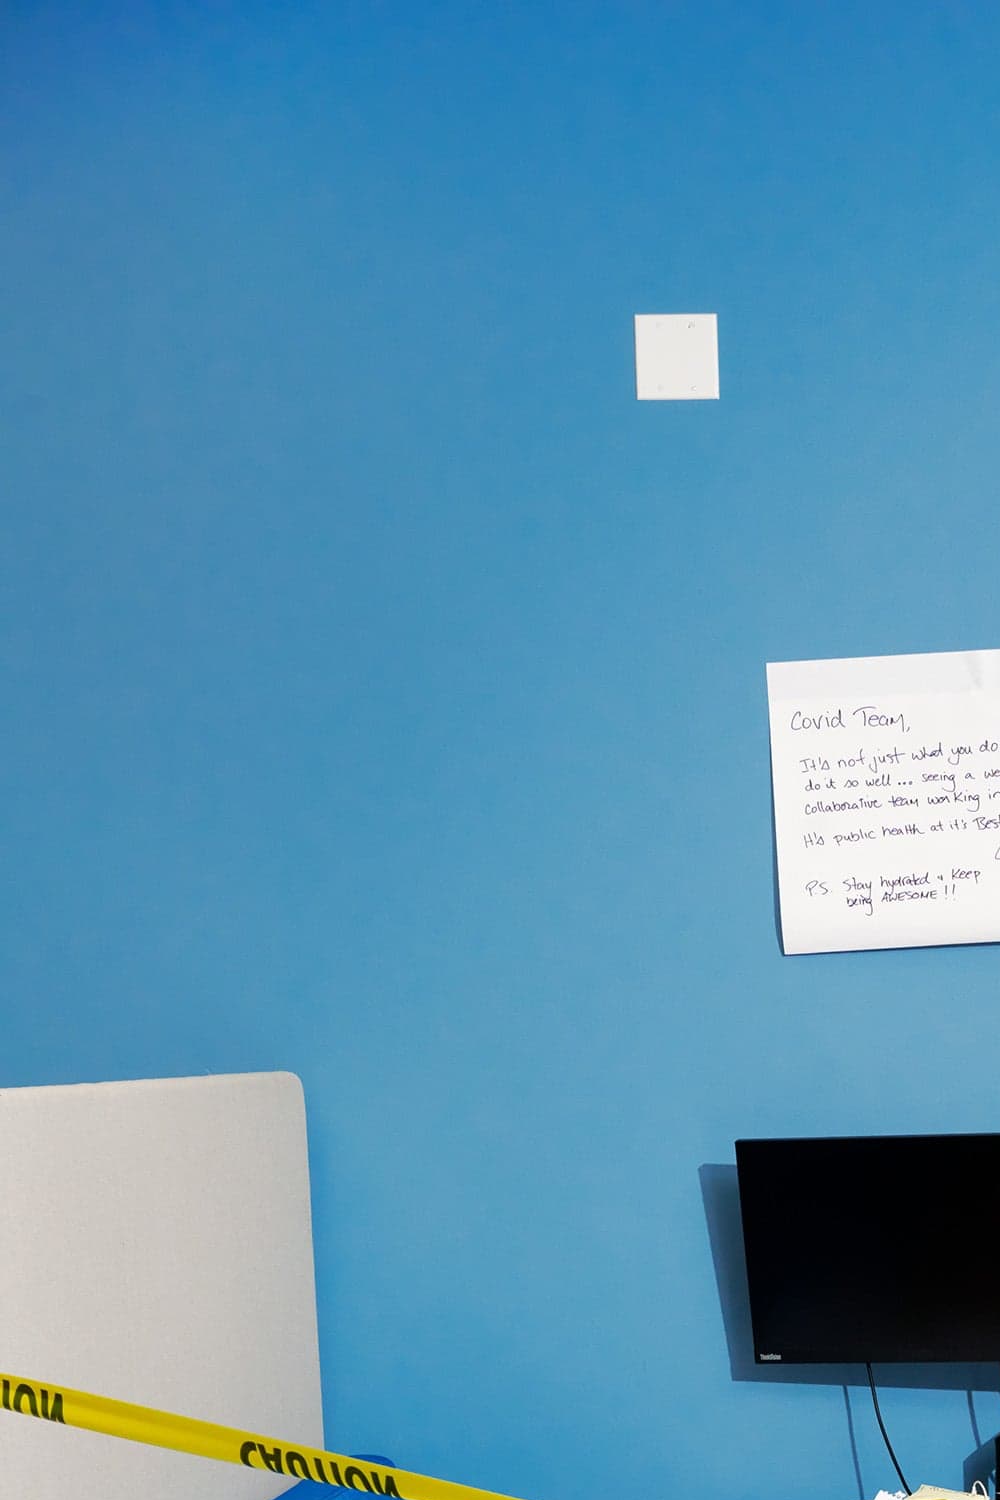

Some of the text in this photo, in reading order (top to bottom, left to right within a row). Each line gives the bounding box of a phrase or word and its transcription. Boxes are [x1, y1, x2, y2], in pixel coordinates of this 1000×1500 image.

[791, 706, 910, 733] Covid Team,
[800, 757, 830, 773] It's
[838, 749, 865, 768] not
[868, 747, 905, 773] just
[911, 742, 944, 761] what
[947, 746, 973, 765] you
[804, 779, 821, 792] do
[824, 777, 837, 790] it
[843, 779, 860, 788] so
[865, 774, 892, 788] well
[921, 772, 956, 793] seeing
[964, 772, 975, 780] a
[888, 795, 919, 808] team
[927, 790, 980, 813] working
[803, 832, 825, 849] It's
[833, 828, 877, 847] public
[881, 823, 926, 837] health
[929, 820, 945, 833] at
[949, 817, 968, 831] it's
[846, 896, 873, 917] being
